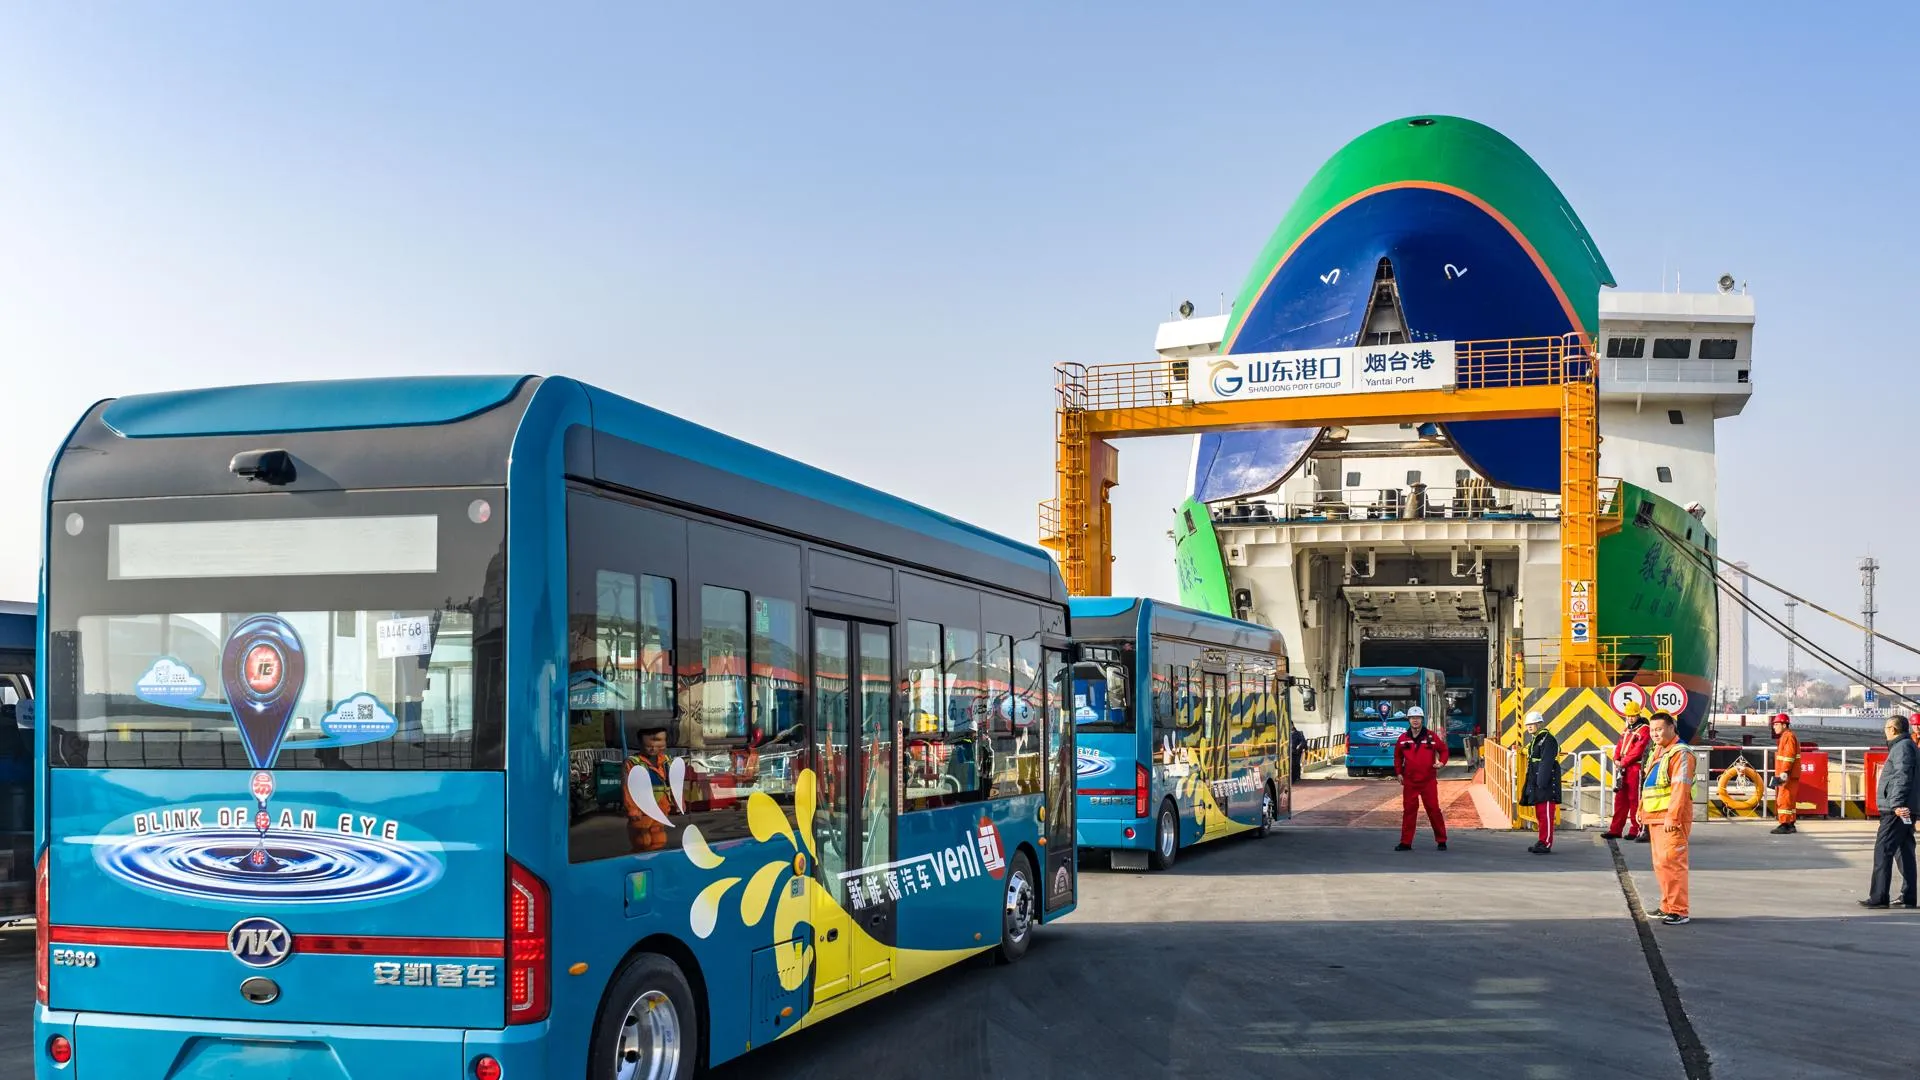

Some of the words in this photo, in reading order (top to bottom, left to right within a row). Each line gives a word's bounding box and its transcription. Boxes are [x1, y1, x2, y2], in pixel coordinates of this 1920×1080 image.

[1248, 357, 1341, 383] 山东港口
[1363, 349, 1435, 373] 烟台港
[1248, 384, 1291, 394] SHANDONG
[1292, 383, 1313, 391] PORT
[1314, 381, 1341, 390] GROUP
[1366, 377, 1393, 387] Yantai
[1395, 375, 1415, 385] Port
[1623, 691, 1633, 707] 5
[135, 809, 200, 834] BLINK
[219, 808, 246, 828] OF
[279, 810, 315, 830] AN
[340, 815, 397, 840] EYE
[847, 864, 932, 910] 新能源汽车
[53, 949, 97, 968] E980
[373, 961, 496, 988] 安凯客车
